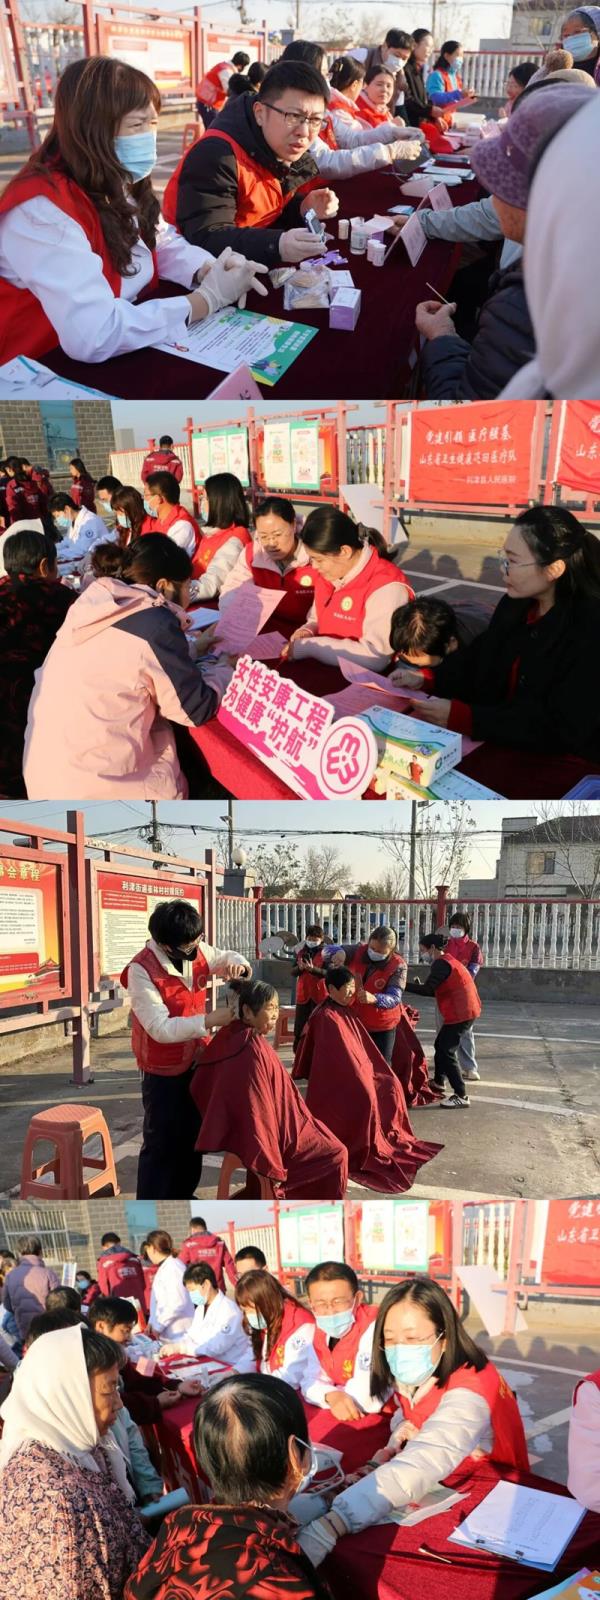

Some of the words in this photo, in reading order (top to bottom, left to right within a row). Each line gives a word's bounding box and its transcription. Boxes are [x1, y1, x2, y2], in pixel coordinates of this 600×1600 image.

[425, 430, 463, 445] 党建引领
[576, 443, 600, 460] 山东
[235, 662, 330, 737] 女性安康工程
